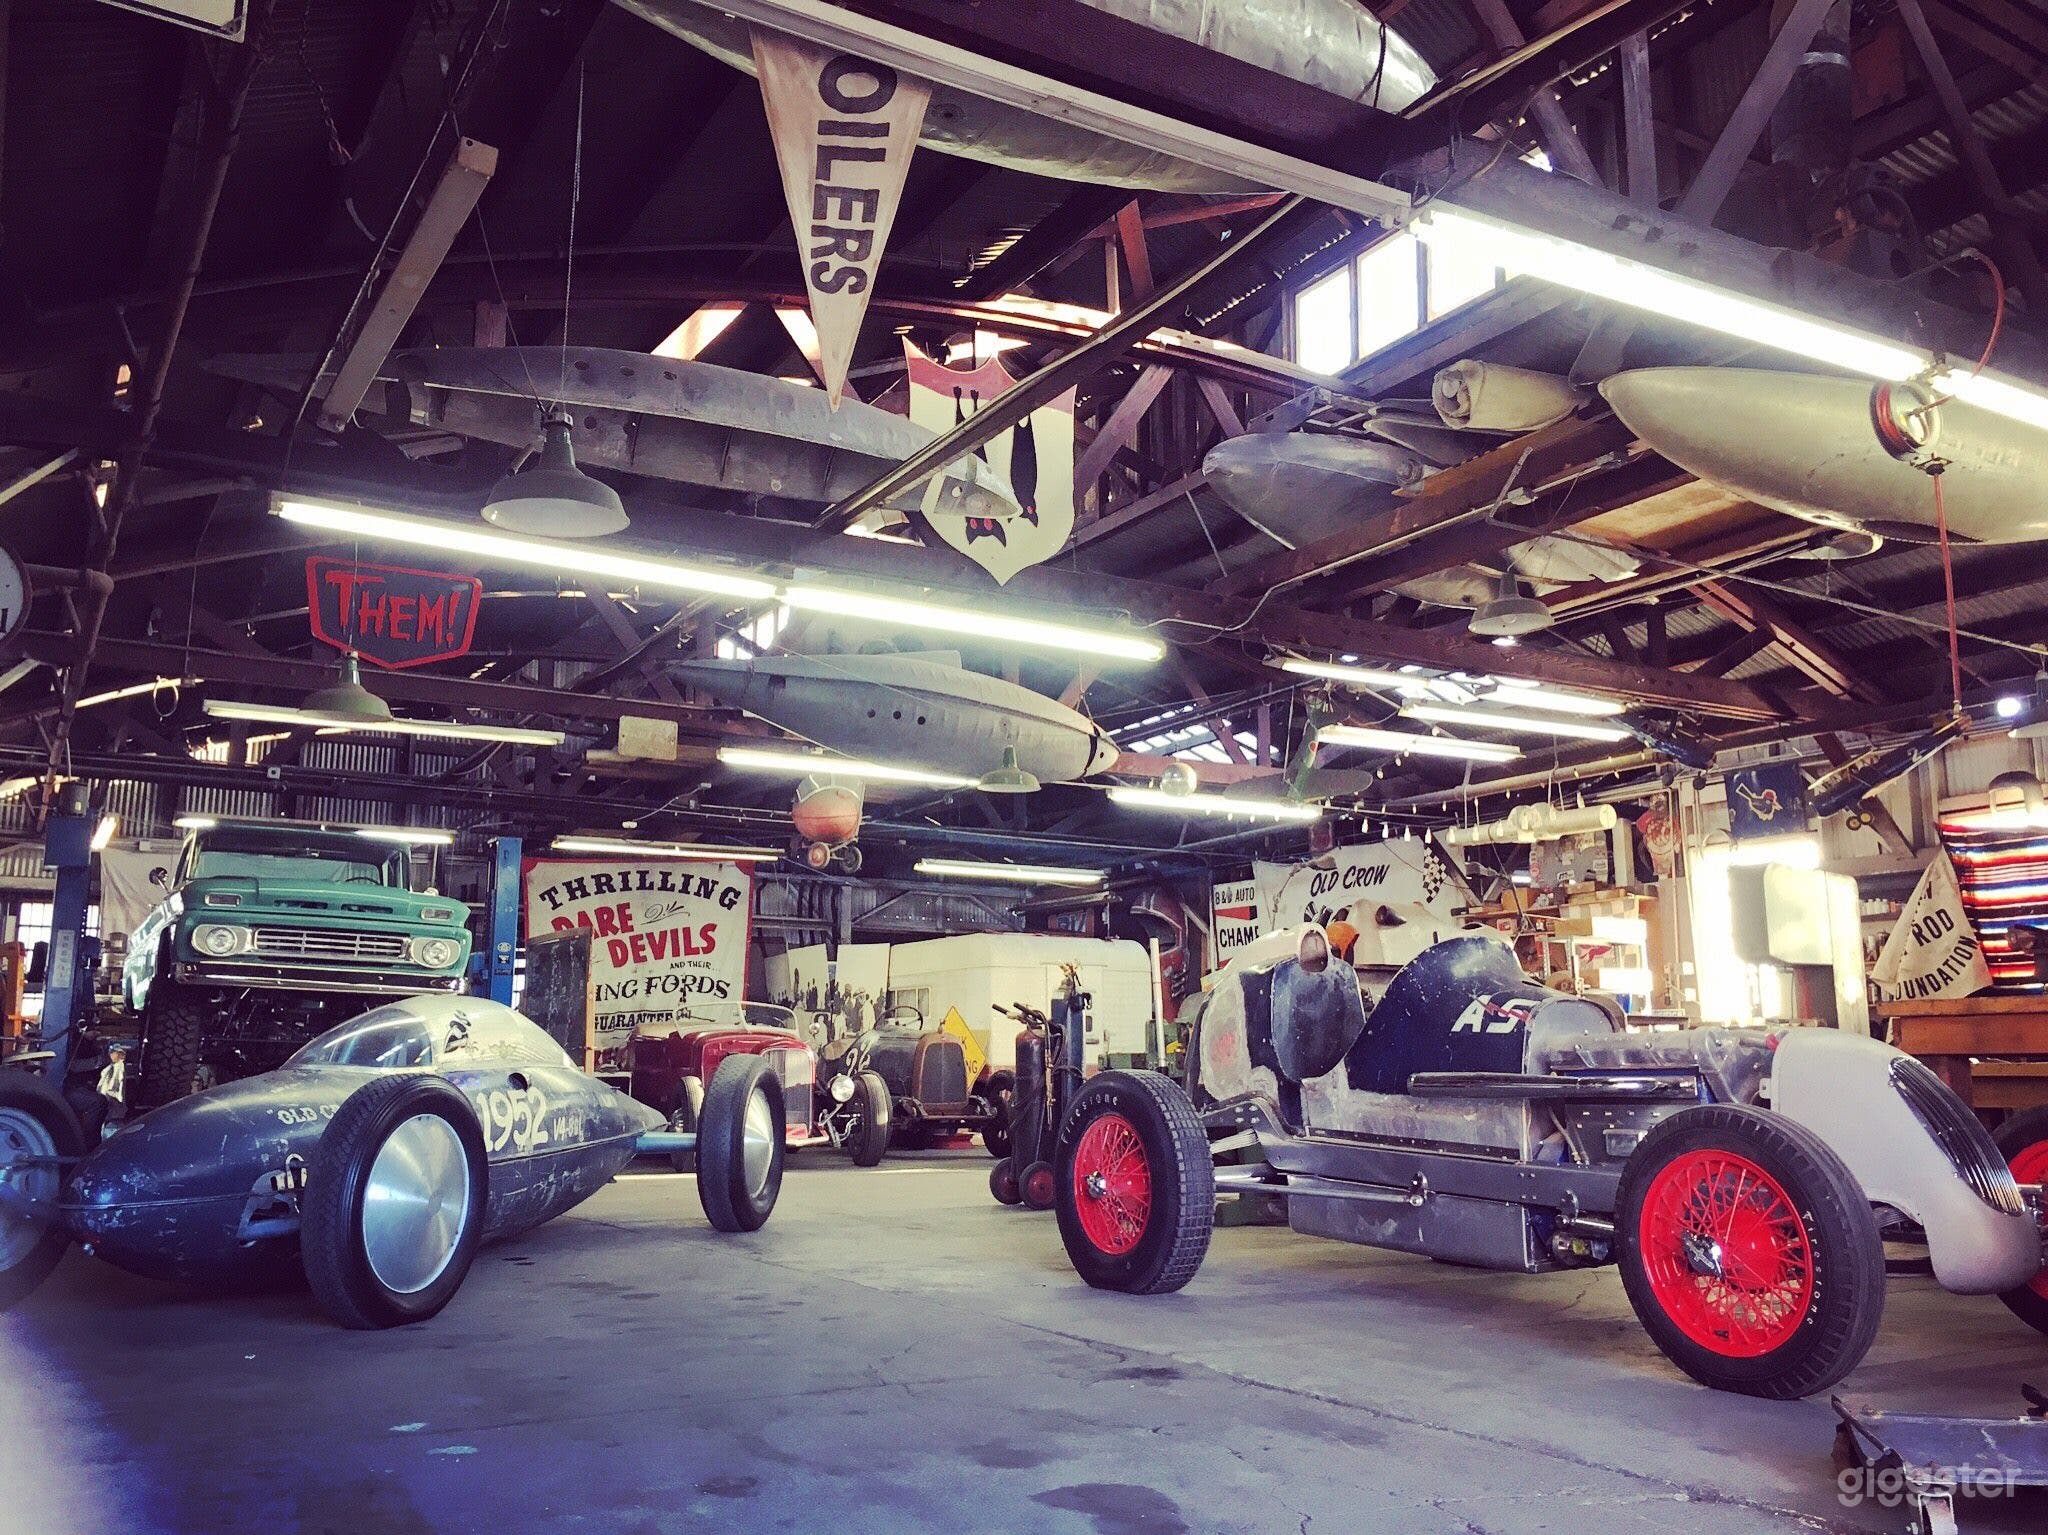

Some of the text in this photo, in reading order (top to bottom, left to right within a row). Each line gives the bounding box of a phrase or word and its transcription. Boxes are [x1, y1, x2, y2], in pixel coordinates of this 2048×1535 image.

[810, 54, 898, 294] OILERS
[325, 570, 461, 649] THEM!
[539, 870, 742, 911] THRILLING
[1235, 887, 1255, 902] AUTO
[1310, 864, 1390, 897] OLD CROW
[551, 902, 634, 940] DARE
[1911, 909, 1954, 946] ROD
[607, 923, 718, 968] DEVILS
[670, 961, 686, 970] AND
[645, 974, 731, 999] FORDS
[476, 1087, 548, 1152] 1952
